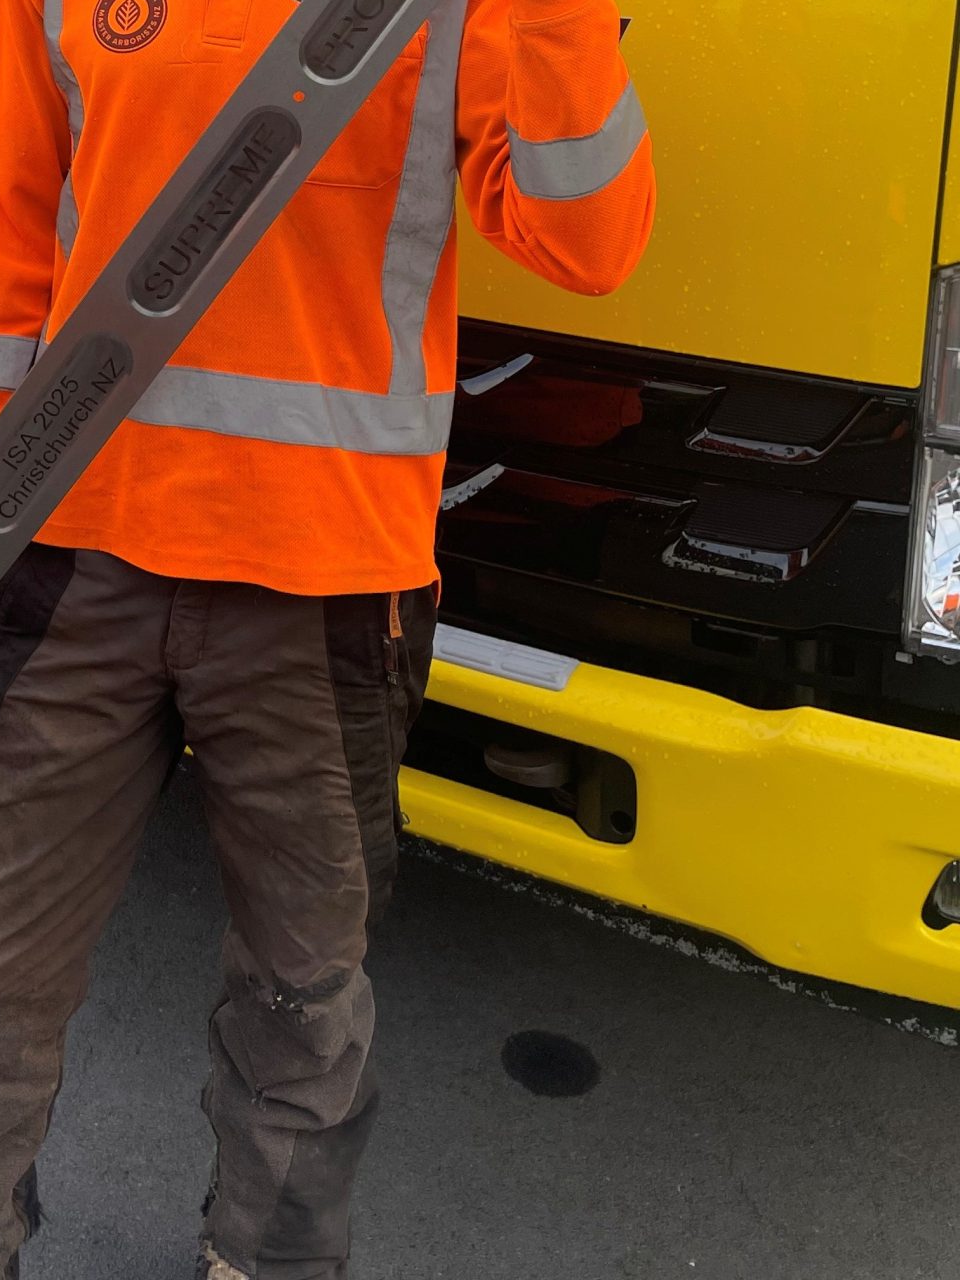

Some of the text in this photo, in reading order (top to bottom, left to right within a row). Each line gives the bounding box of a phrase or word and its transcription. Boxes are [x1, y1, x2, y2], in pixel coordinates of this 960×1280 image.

[97, 5, 161, 46] MASTER ARBORISTS NZ
[144, 122, 279, 300] SUPREME
[91, 358, 126, 395] NZ
[2, 375, 80, 471] ISA 2025
